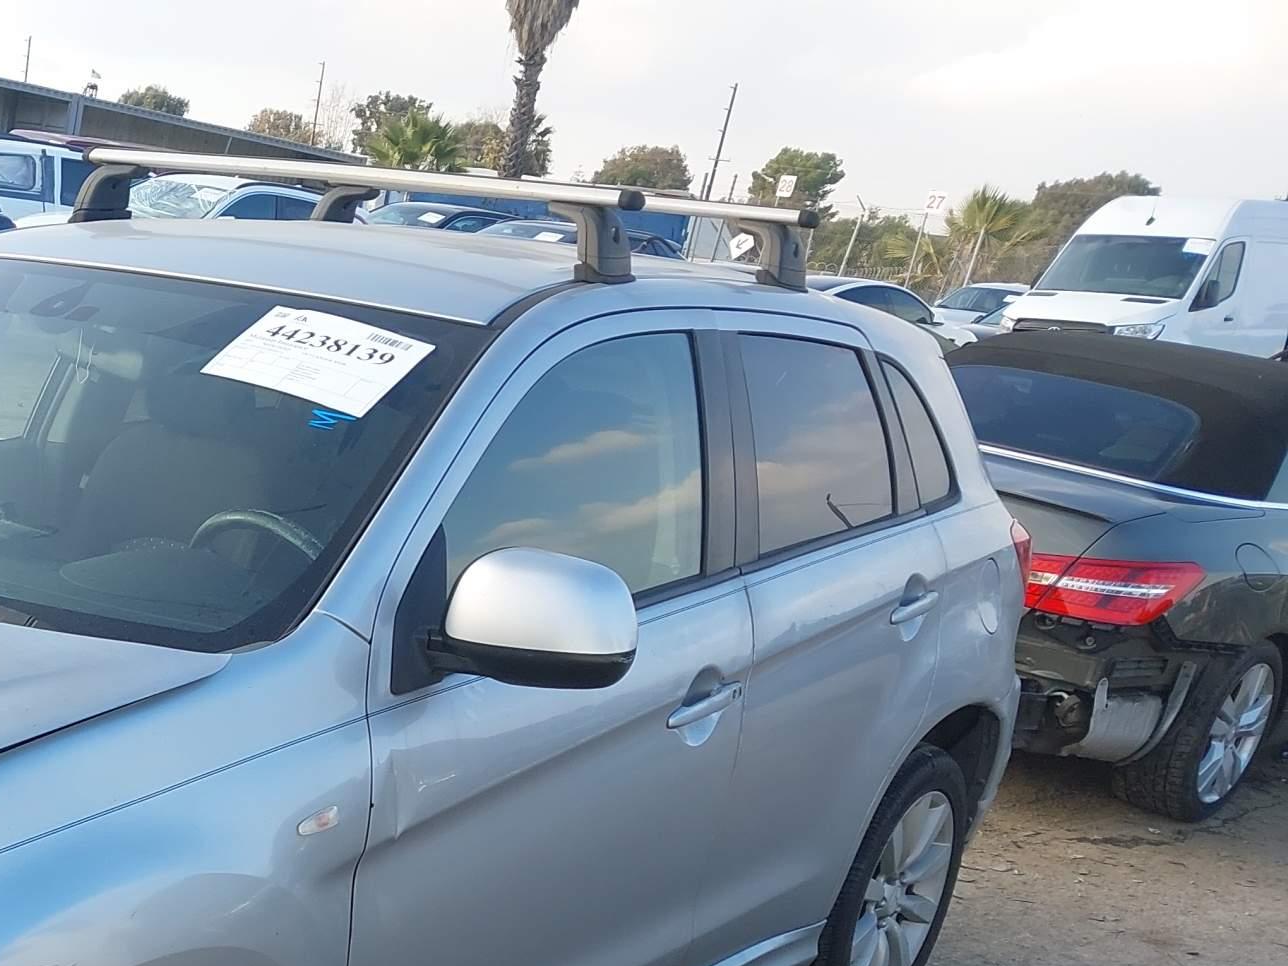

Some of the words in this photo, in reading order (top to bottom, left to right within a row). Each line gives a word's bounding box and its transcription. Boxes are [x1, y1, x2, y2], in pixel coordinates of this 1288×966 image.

[779, 179, 794, 193] 28
[926, 195, 946, 209] 27
[265, 324, 396, 365] 44238139
